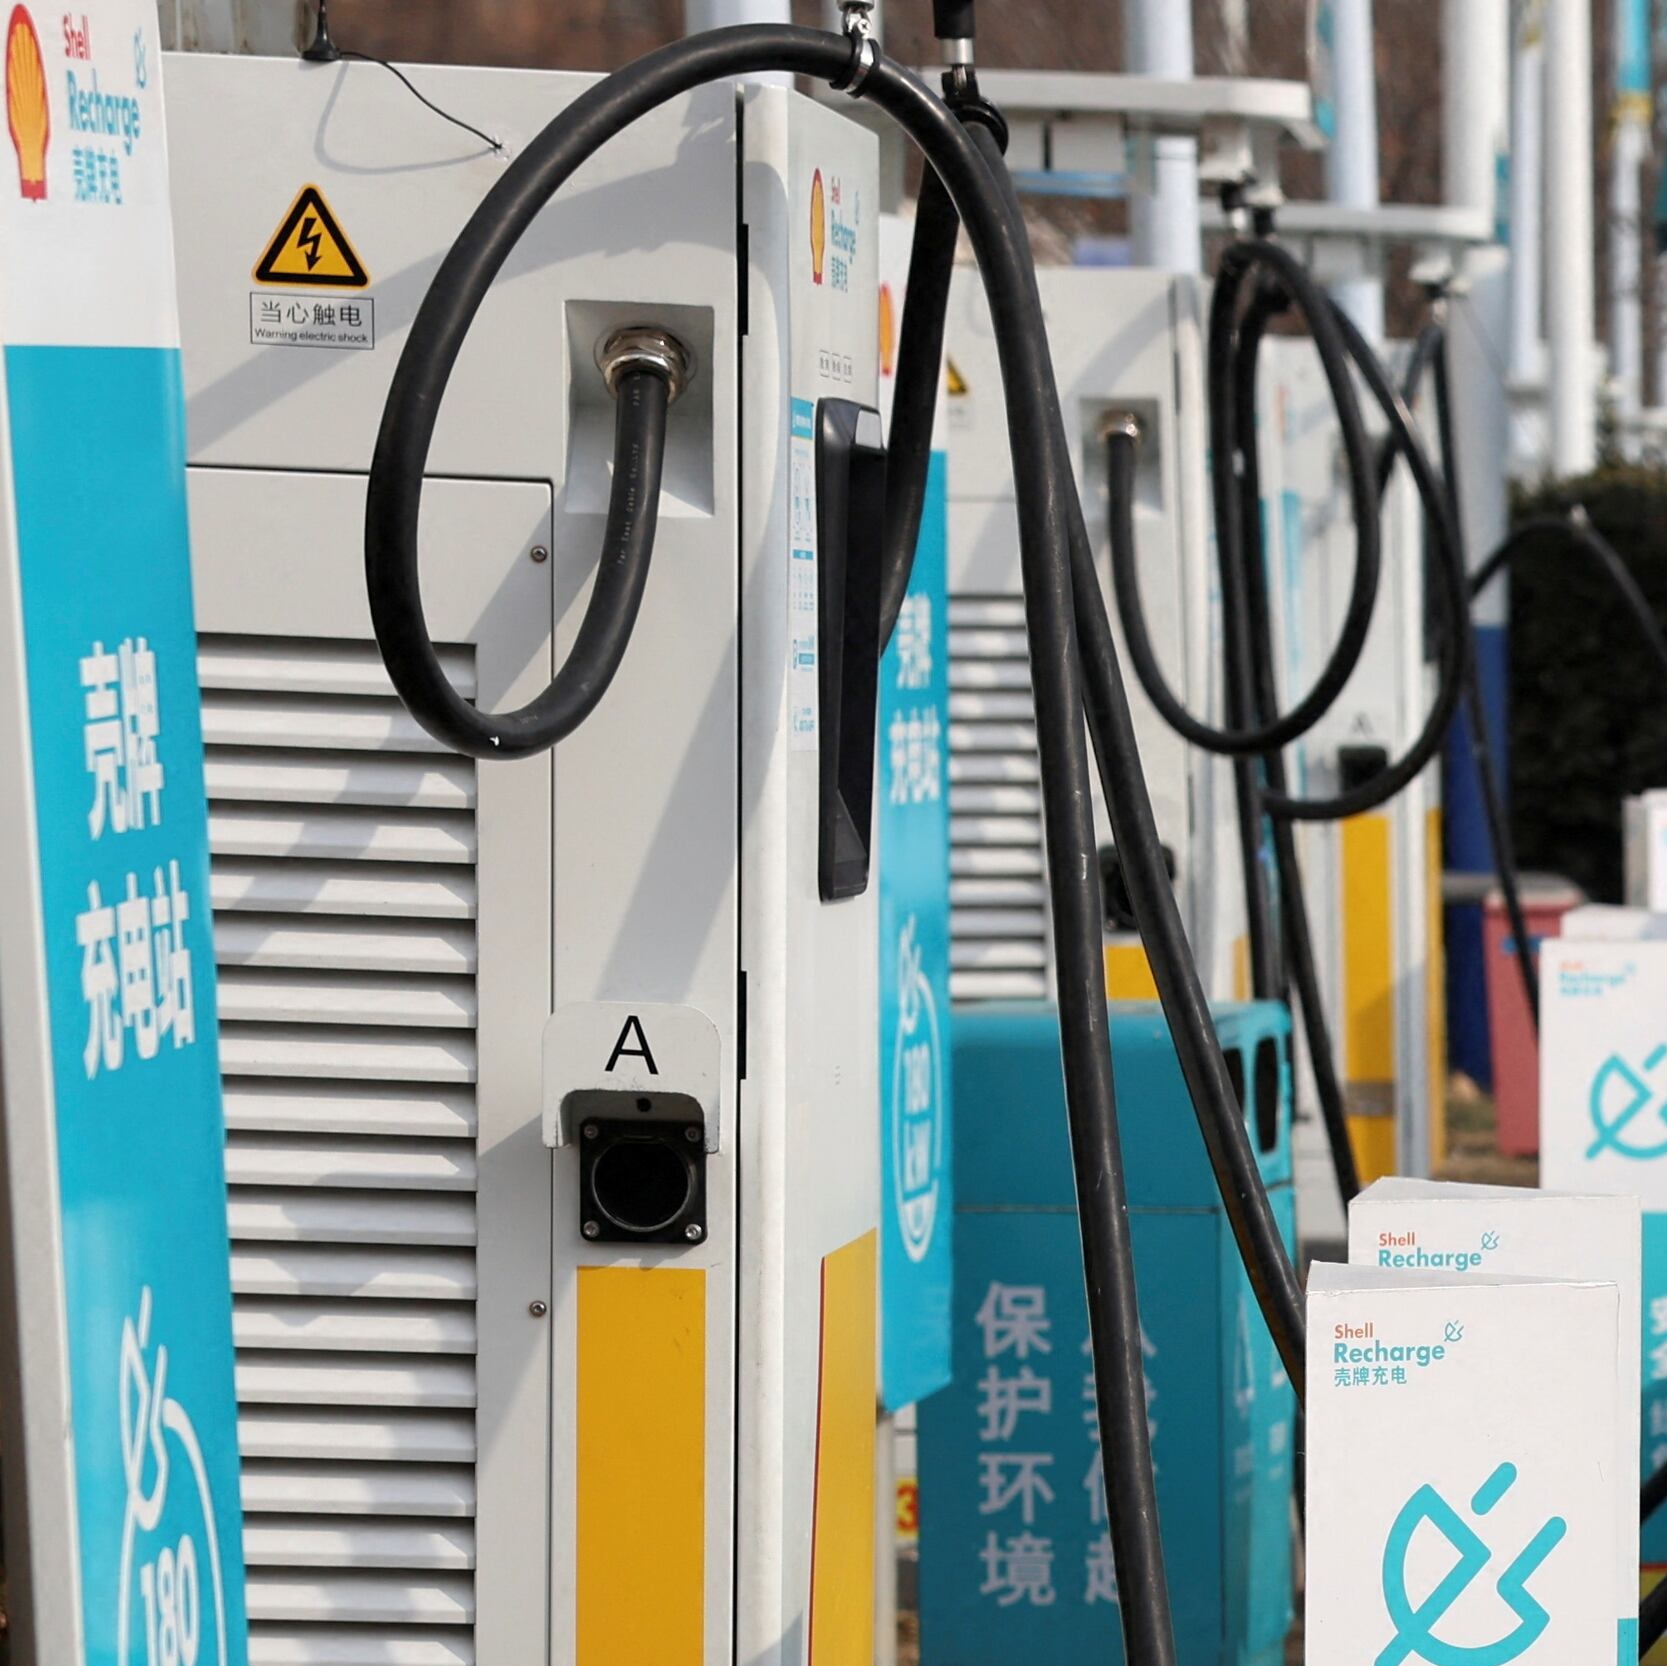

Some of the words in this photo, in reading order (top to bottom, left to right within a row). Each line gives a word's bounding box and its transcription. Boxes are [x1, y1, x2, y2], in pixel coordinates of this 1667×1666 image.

[66, 68, 140, 156] Recharge
[260, 301, 362, 327] 当心触电
[255, 328, 297, 341] Warning
[299, 331, 336, 342] electric
[338, 333, 368, 343] shock
[76, 858, 196, 1080] 充电站
[604, 1015, 659, 1075] A
[1378, 1232, 1416, 1246] Shell
[1378, 1247, 1482, 1271] Recharge
[1334, 1322, 1374, 1339] Shell
[1334, 1340, 1446, 1367] Recharge
[1334, 1365, 1407, 1387] 壳牌充电
[976, 1281, 1057, 1606] 保护环境
